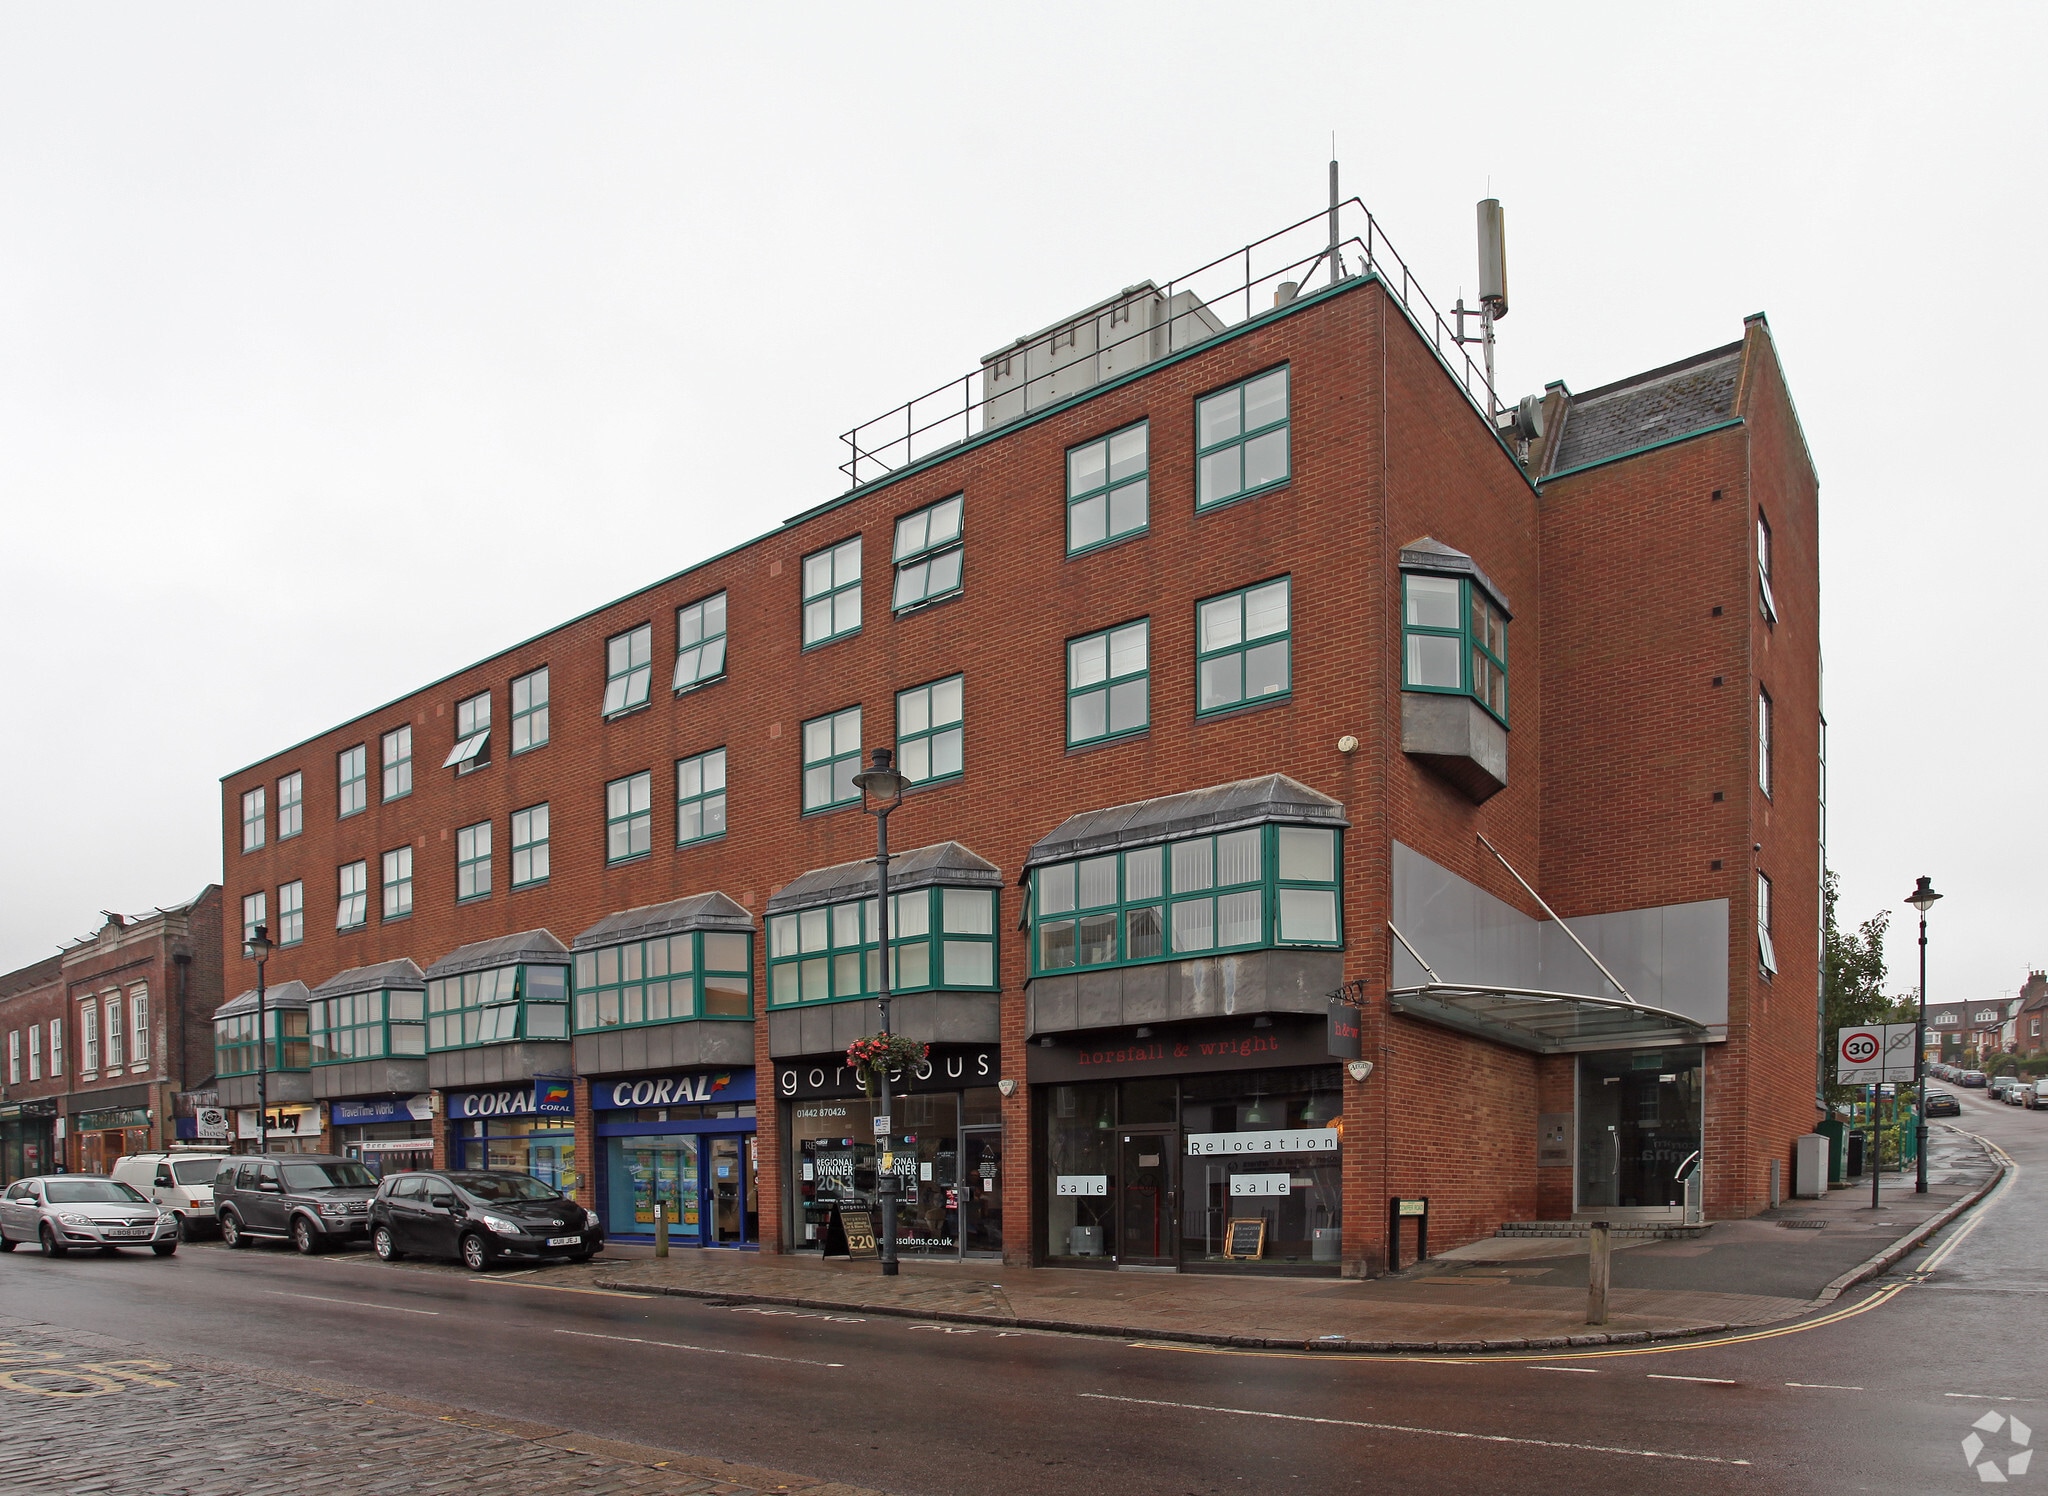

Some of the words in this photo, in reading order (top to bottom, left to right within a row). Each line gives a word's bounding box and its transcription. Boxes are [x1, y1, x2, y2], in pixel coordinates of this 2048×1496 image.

[1334, 1020, 1359, 1039] h&w
[1078, 1045, 1164, 1065] horsfall
[1173, 1042, 1188, 1058] &
[1200, 1035, 1279, 1057] wright
[1848, 1042, 1874, 1055] 30
[612, 1075, 712, 1107] CORAL
[375, 1104, 394, 1115] World
[463, 1090, 537, 1116] CORAL
[540, 1103, 571, 1112] CORAL
[796, 1109, 818, 1118] 01442
[819, 1107, 847, 1117] 870426
[199, 1129, 226, 1138] shoes
[1191, 1137, 1333, 1155] Relocation
[816, 1158, 853, 1167] REGIONAL
[877, 1157, 917, 1166] RONAL
[816, 1166, 854, 1176] WINNER
[877, 1165, 917, 1175] WNNER
[816, 1176, 853, 1191] 2013
[1060, 1181, 1104, 1194] sale
[1235, 1180, 1287, 1193] sale
[848, 1235, 875, 1250] £20
